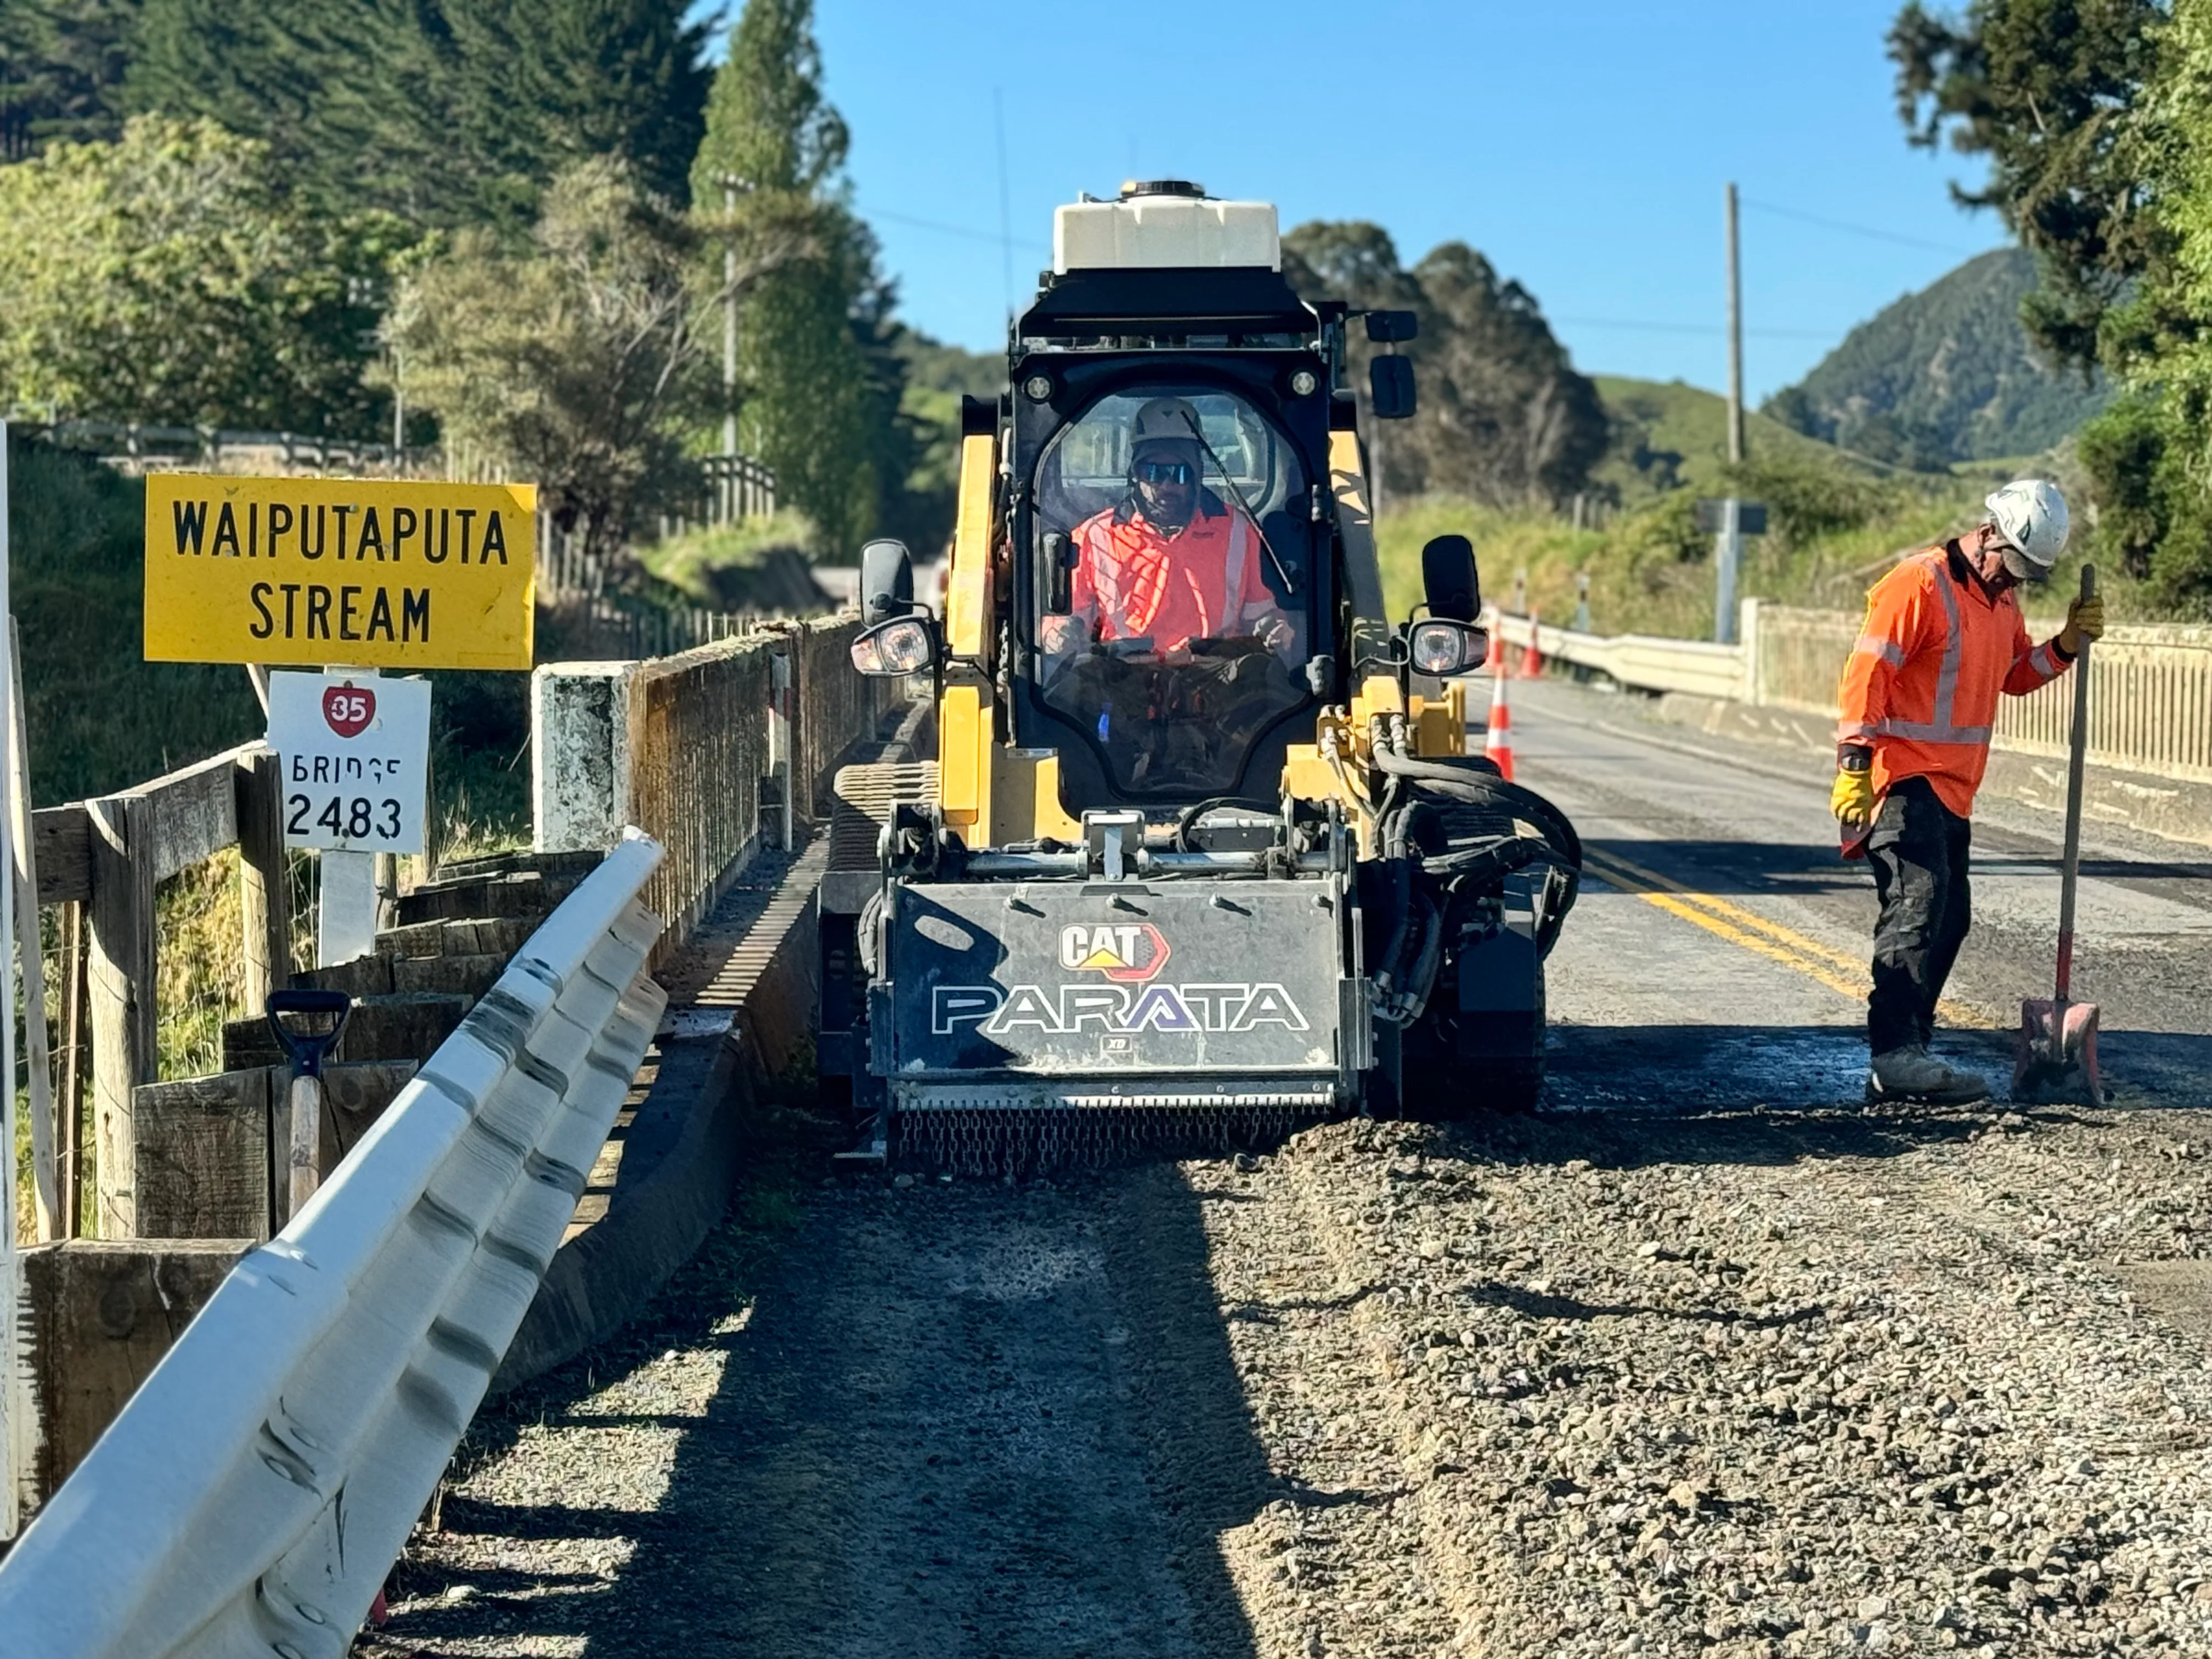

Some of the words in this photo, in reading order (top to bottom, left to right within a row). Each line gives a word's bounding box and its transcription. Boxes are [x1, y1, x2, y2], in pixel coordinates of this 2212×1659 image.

[172, 500, 508, 566] WAIPUTAPUTA
[250, 583, 430, 642] STREAM
[331, 695, 367, 722] 35
[287, 793, 401, 840] 2483
[1062, 926, 1142, 967] CAT
[932, 983, 1310, 1034] PARATA
